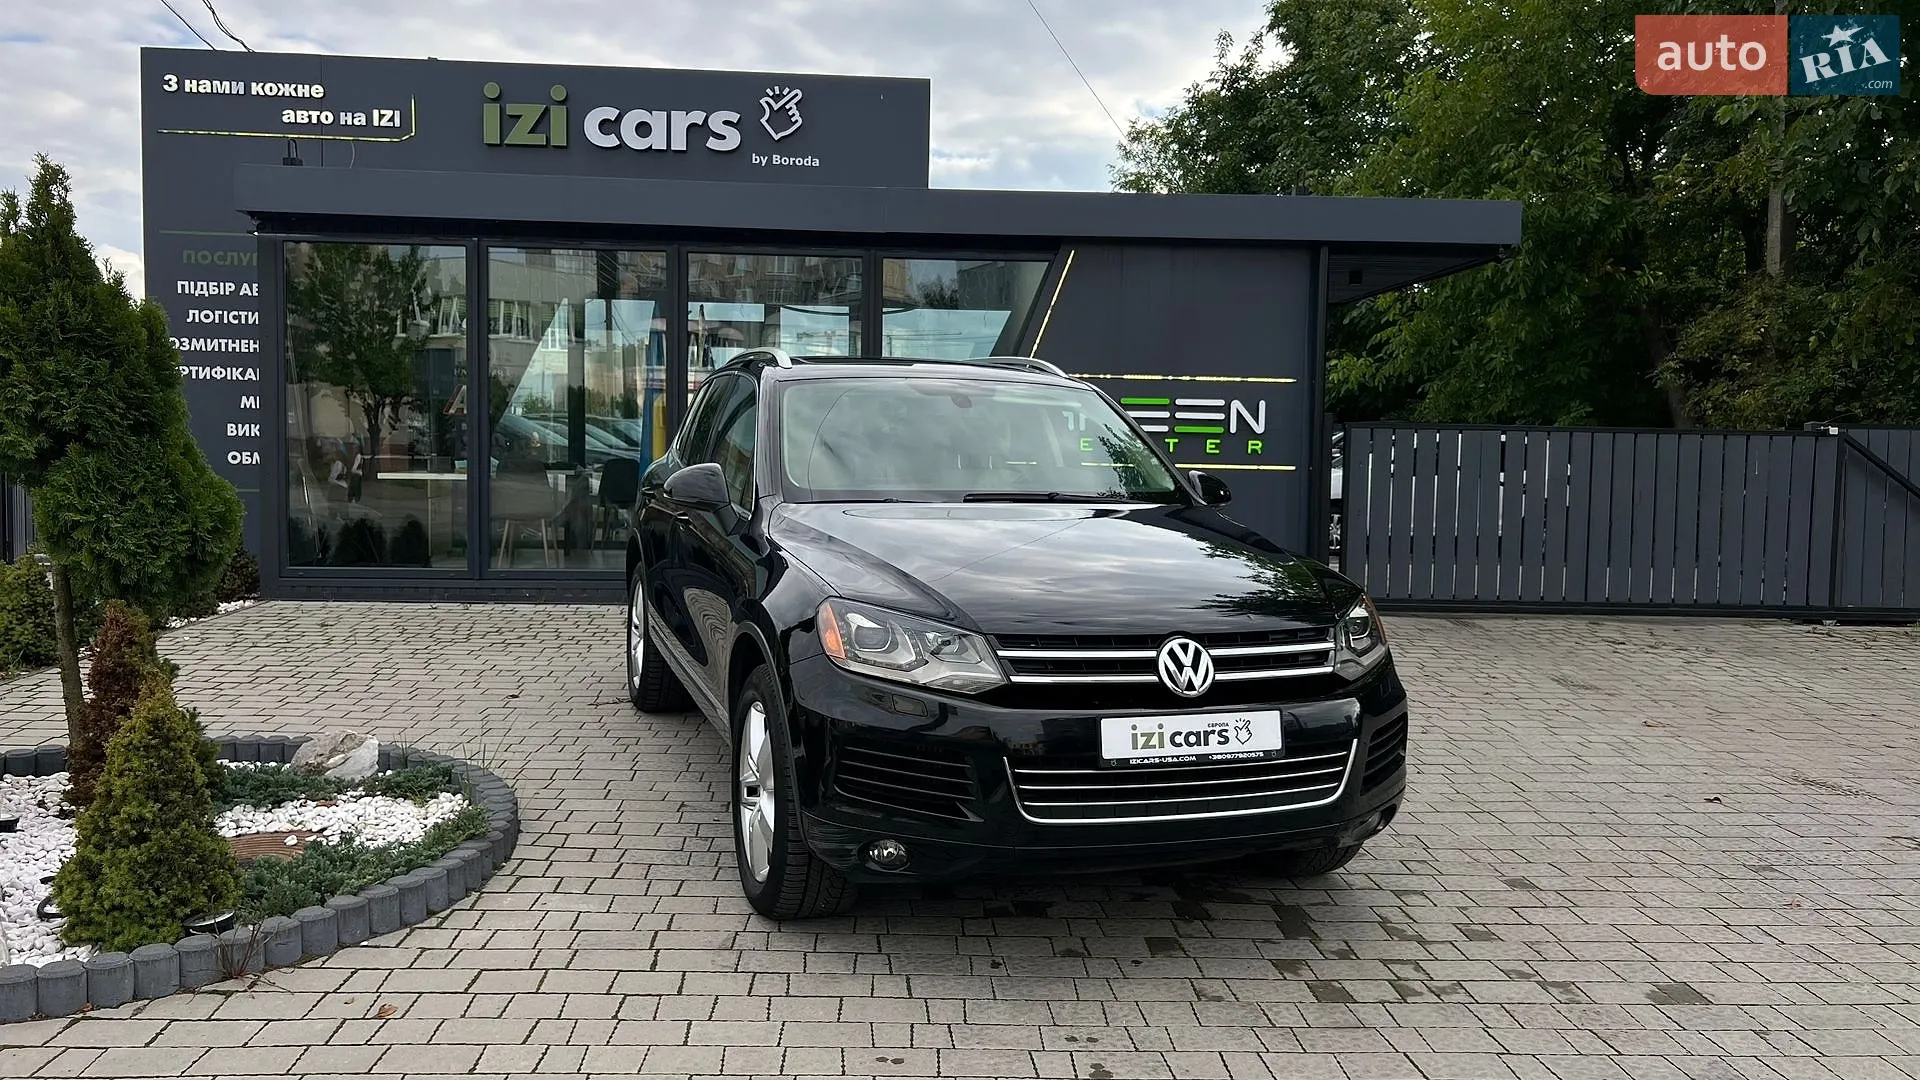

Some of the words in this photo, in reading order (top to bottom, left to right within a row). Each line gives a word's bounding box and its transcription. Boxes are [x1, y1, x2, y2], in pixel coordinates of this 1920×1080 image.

[184, 78, 245, 95] нами
[250, 80, 325, 98] кожне
[281, 108, 334, 125] авто
[339, 110, 367, 126] на
[372, 109, 401, 127] IZI
[483, 82, 567, 146] izi
[583, 106, 742, 151] cars
[751, 152, 768, 167] by
[772, 153, 820, 167] Boroda
[177, 280, 236, 297] ПІДБІР
[186, 309, 259, 325] ЛОГІСТИ
[175, 366, 260, 381] РТИФІКА
[1131, 723, 1165, 750] izi
[1169, 728, 1230, 748] cars
